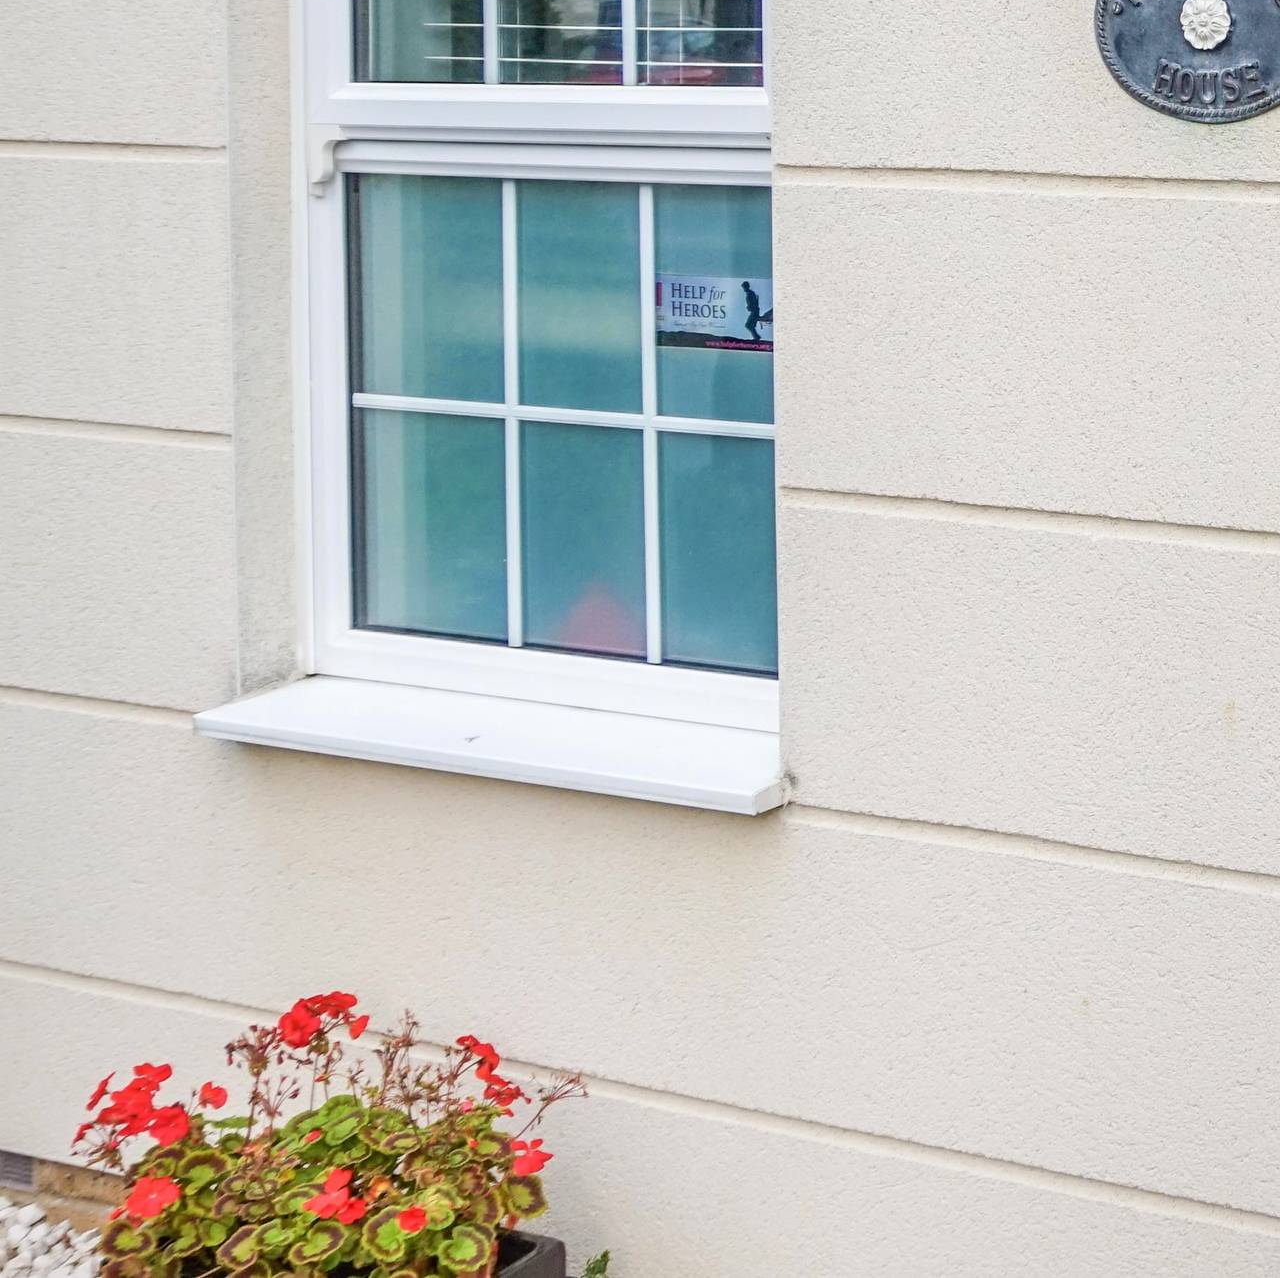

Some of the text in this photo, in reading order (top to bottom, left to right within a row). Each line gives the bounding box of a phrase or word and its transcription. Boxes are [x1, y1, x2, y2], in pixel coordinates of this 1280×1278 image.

[1153, 58, 1267, 104] HOUSE
[671, 282, 726, 303] HELP for
[671, 301, 727, 319] HEROES
